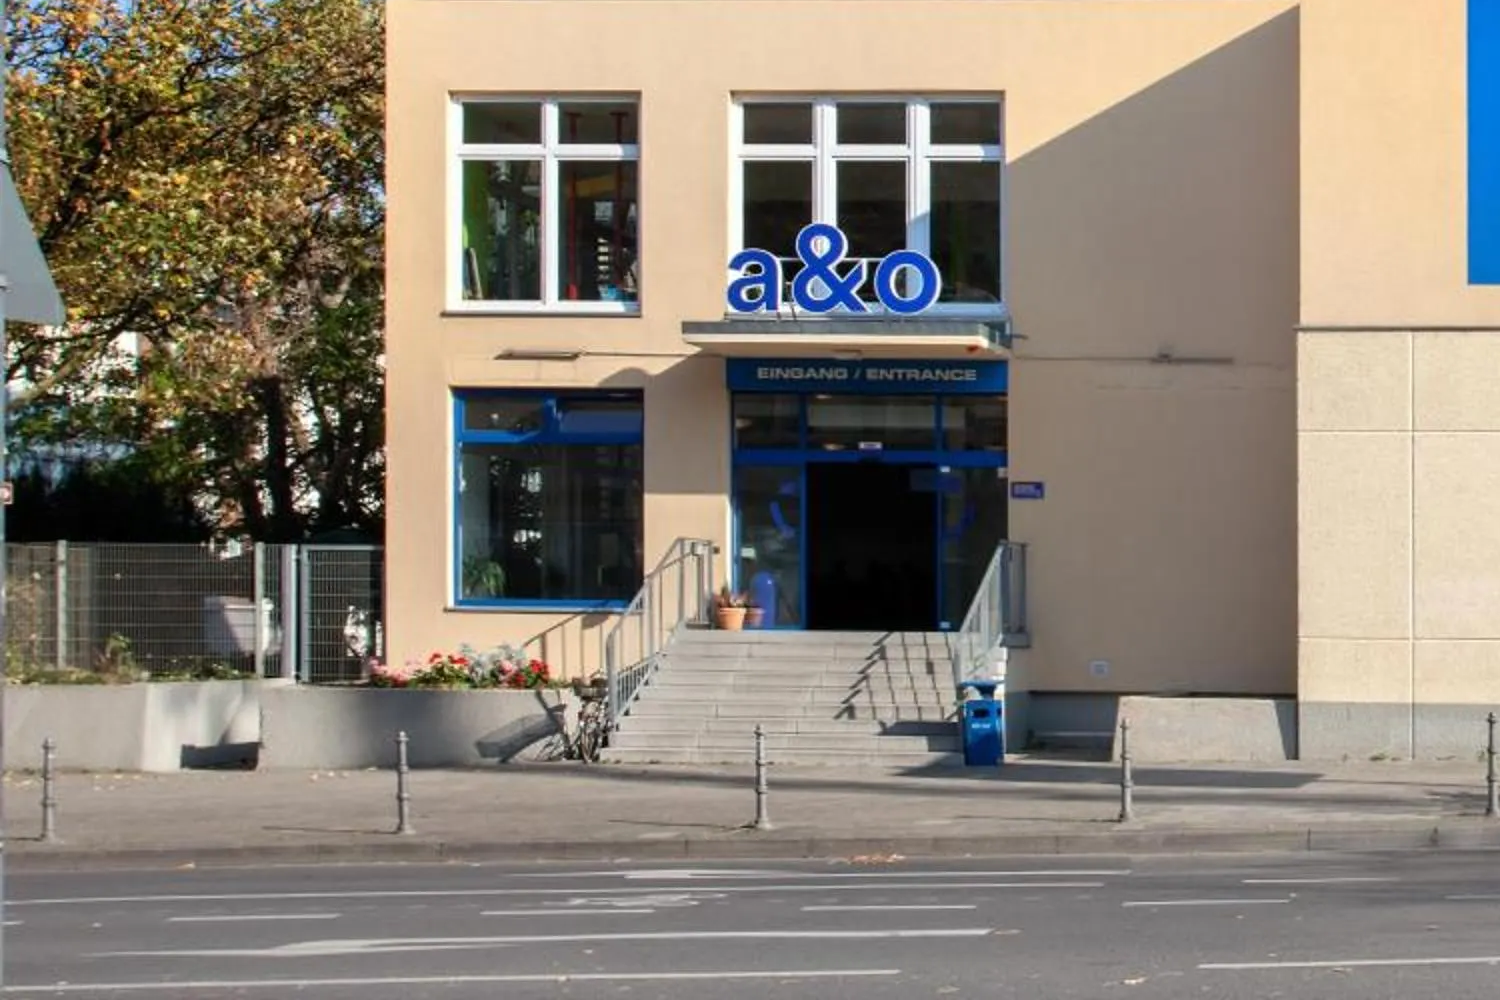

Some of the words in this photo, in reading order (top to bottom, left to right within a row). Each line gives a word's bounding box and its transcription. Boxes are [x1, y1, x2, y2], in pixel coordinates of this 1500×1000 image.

[726, 222, 942, 316] a&o
[757, 367, 848, 380] EINGANG
[866, 367, 977, 381] ENTRANCE
